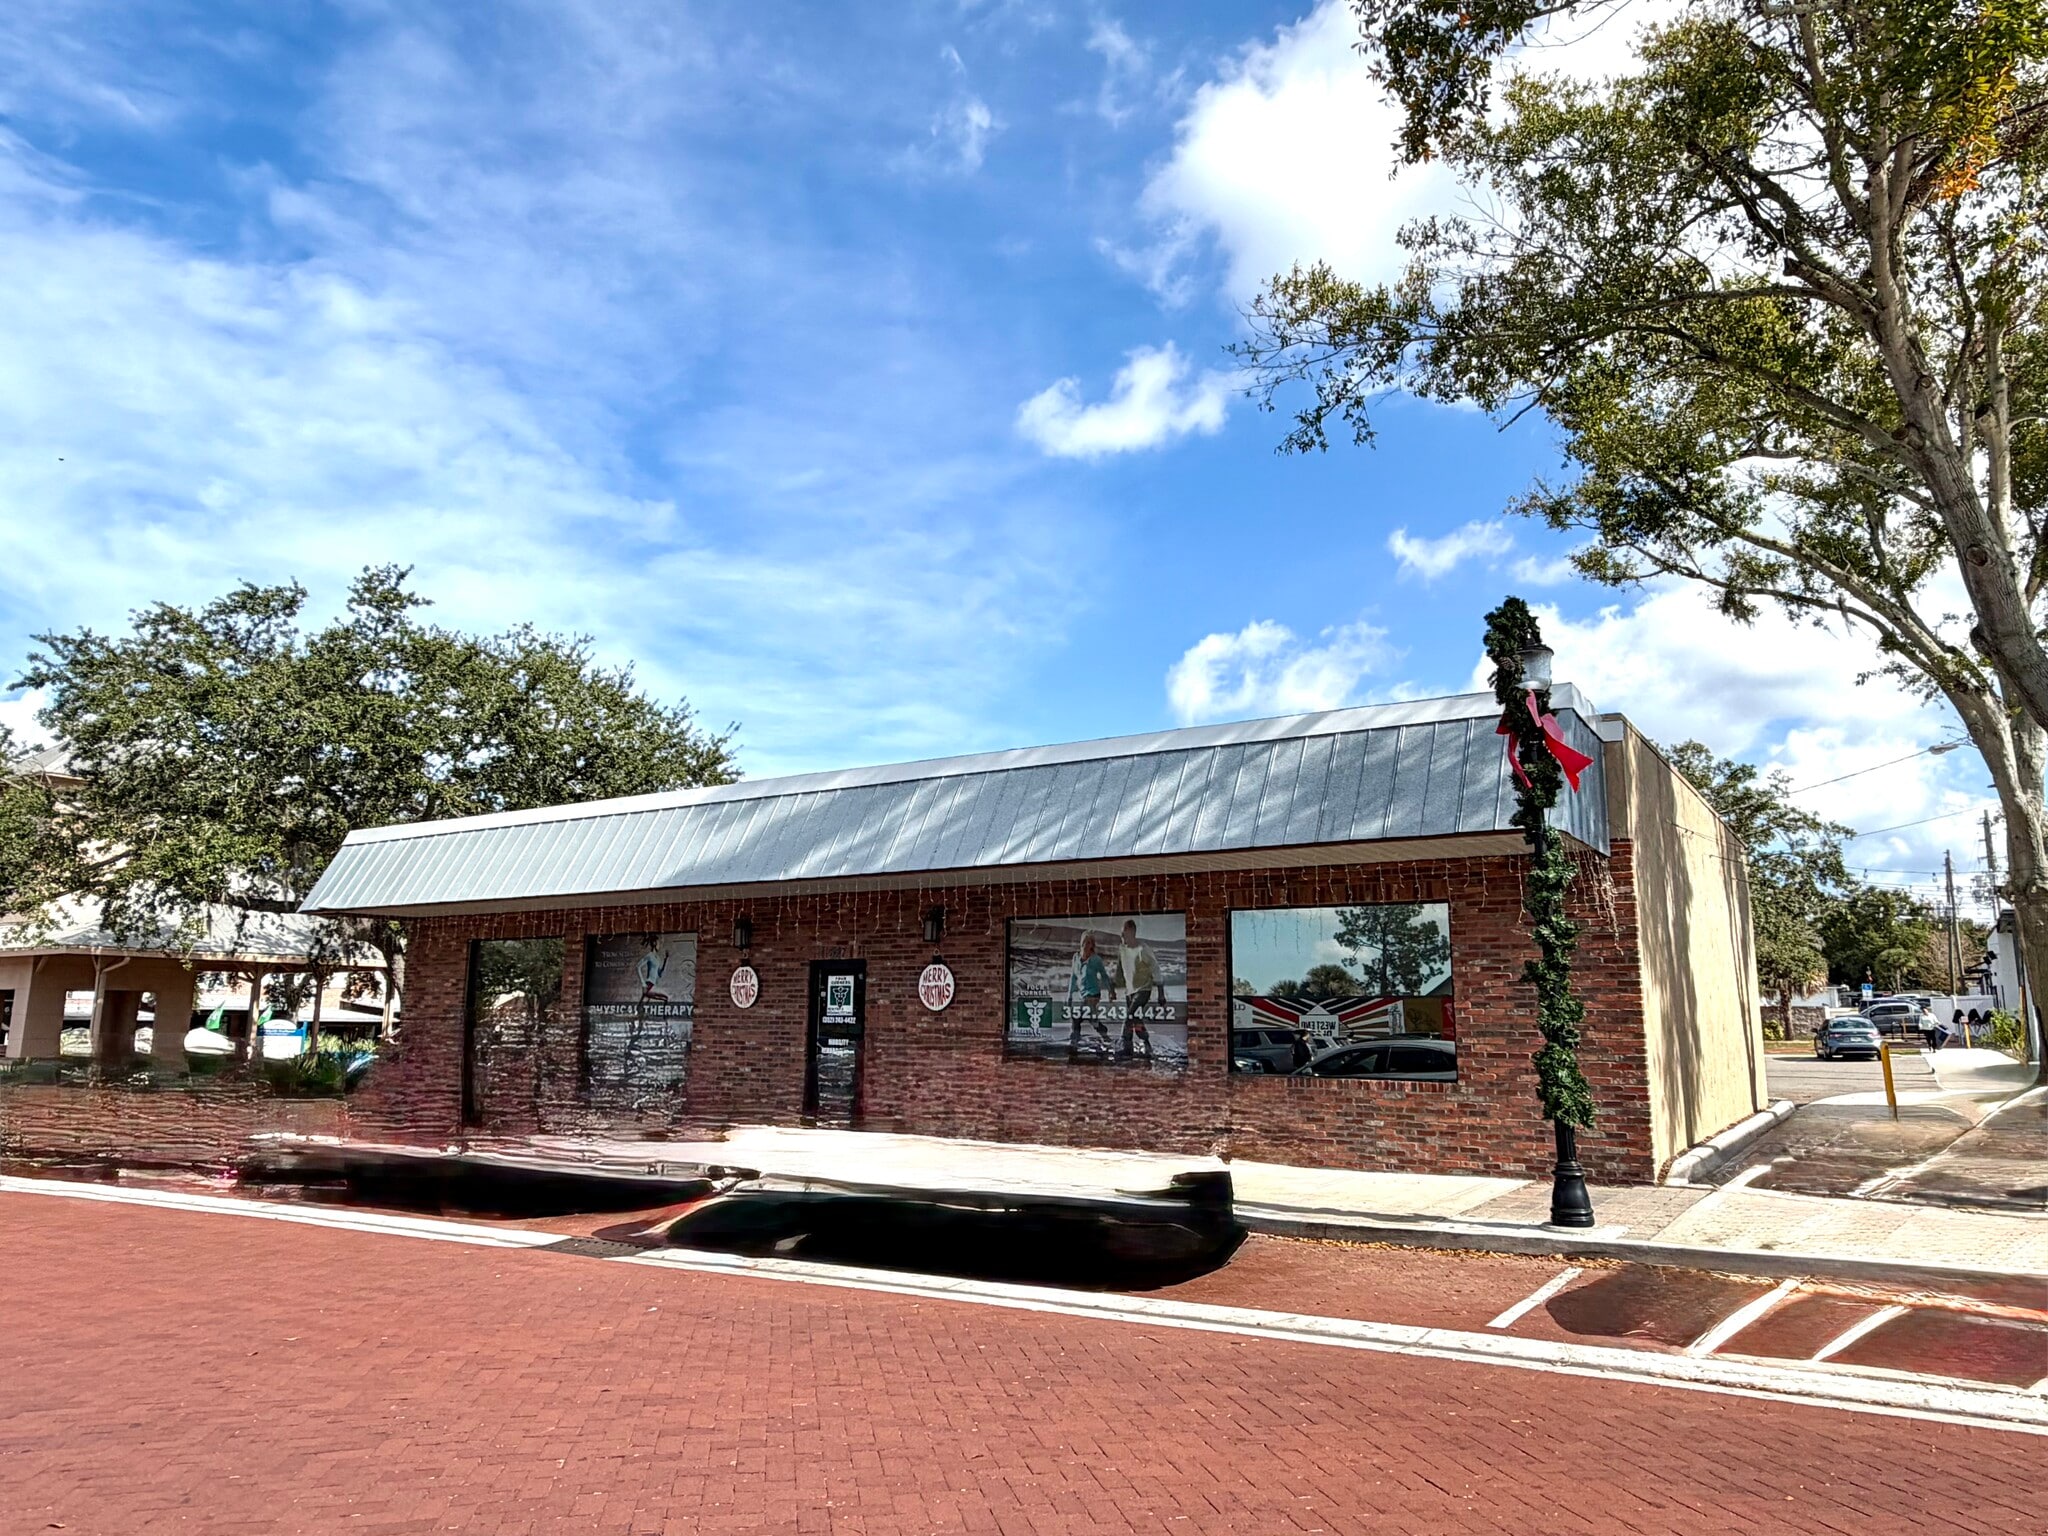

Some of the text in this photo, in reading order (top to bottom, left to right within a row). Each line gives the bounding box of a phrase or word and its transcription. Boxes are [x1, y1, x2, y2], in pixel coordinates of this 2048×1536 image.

[734, 969, 753, 983] MERRY
[923, 967, 948, 984] MERRY
[590, 1005, 693, 1016] PHYSICAL THERAPY
[1062, 1006, 1176, 1020] 352.243.4422
